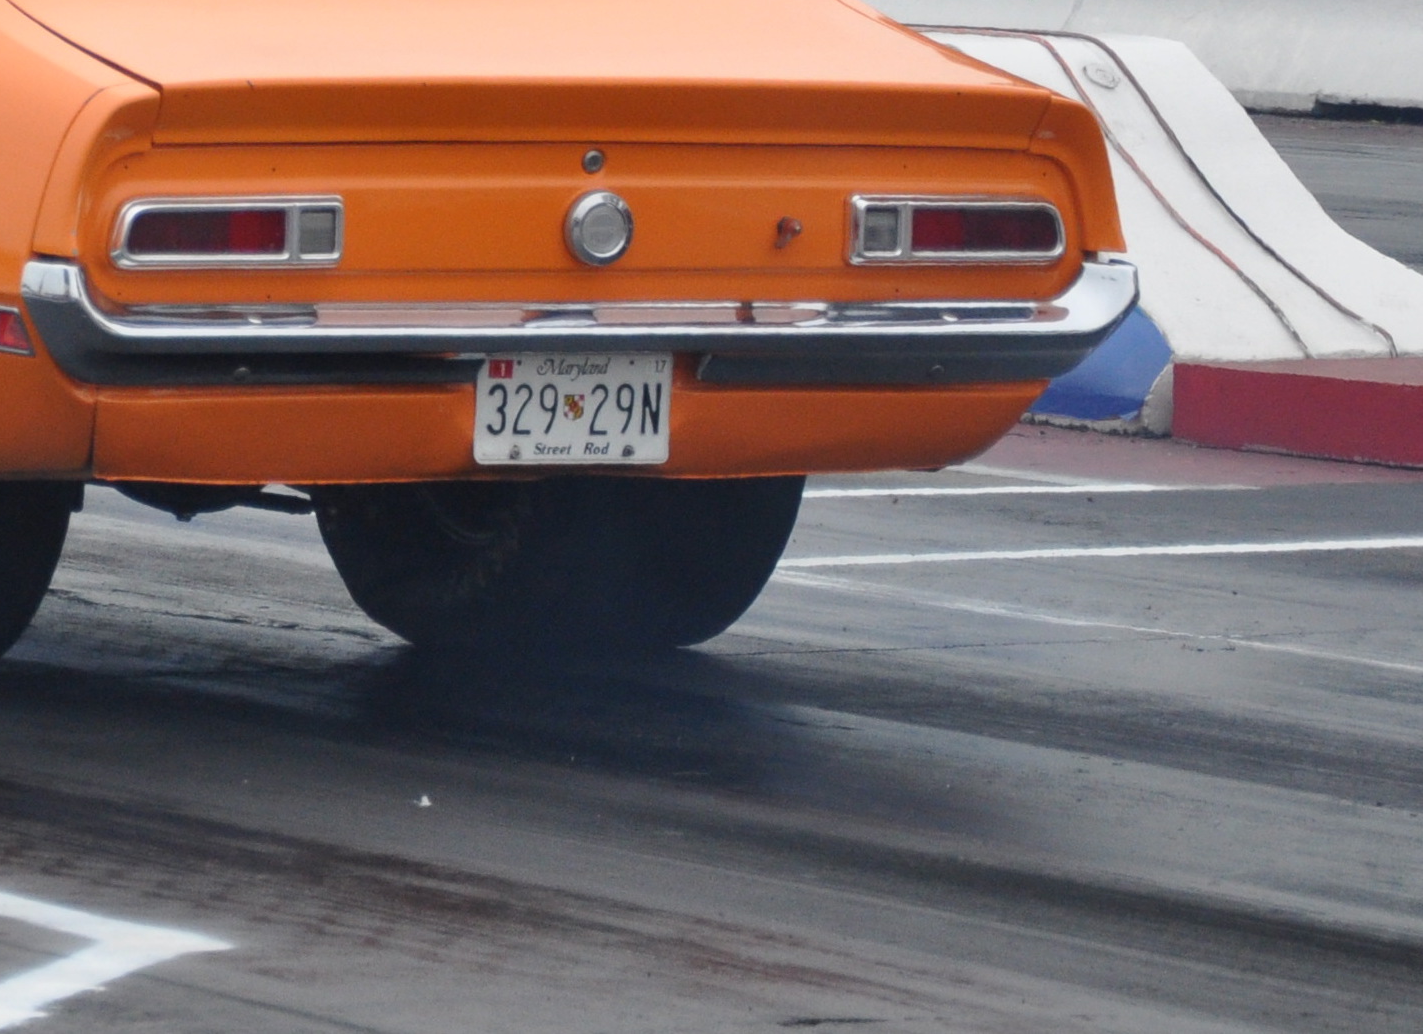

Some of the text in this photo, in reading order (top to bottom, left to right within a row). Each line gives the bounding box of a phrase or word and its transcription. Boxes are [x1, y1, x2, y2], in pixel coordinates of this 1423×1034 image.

[536, 357, 611, 382] Maryland
[487, 382, 662, 435] 329 29N
[533, 442, 610, 455] Street Rod
